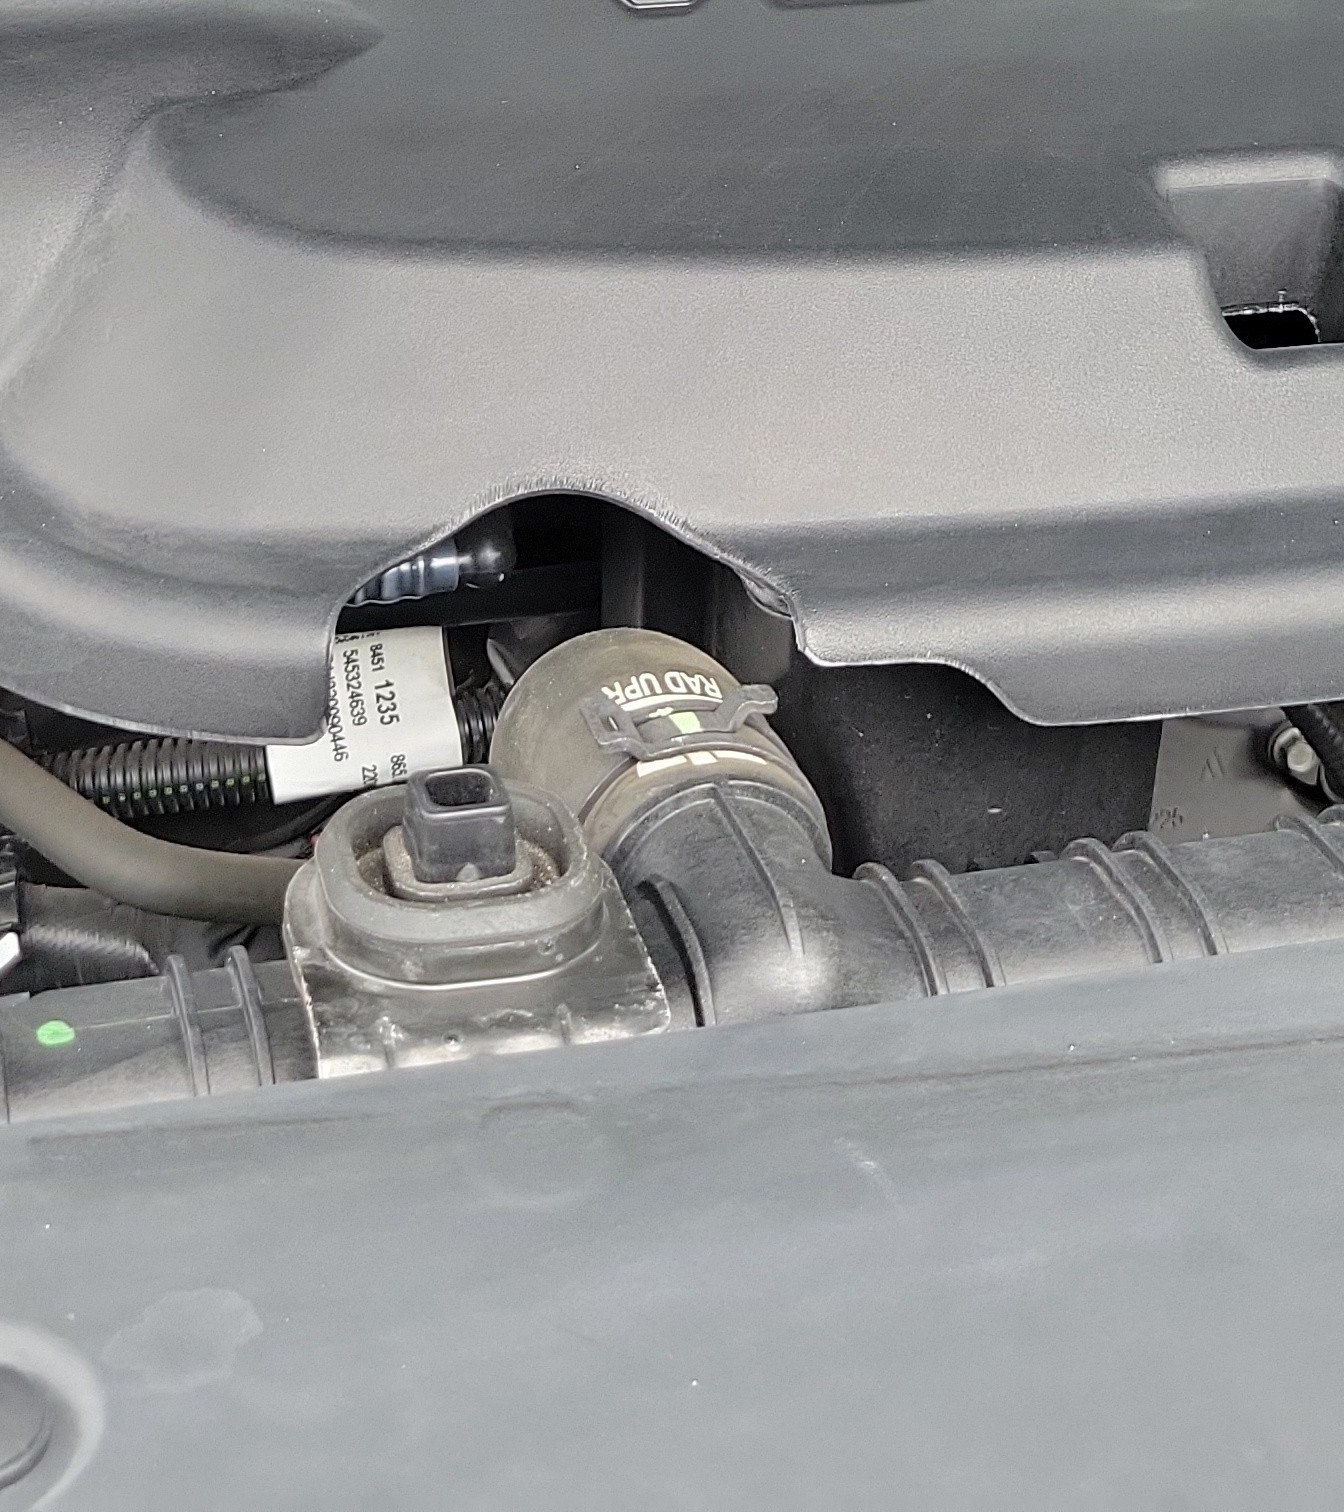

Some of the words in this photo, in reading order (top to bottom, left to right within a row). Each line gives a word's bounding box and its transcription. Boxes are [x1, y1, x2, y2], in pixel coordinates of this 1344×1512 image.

[369, 643, 385, 672] 8451
[343, 649, 369, 727] 545324639
[374, 679, 401, 726] 1235
[665, 671, 723, 699] RAD
